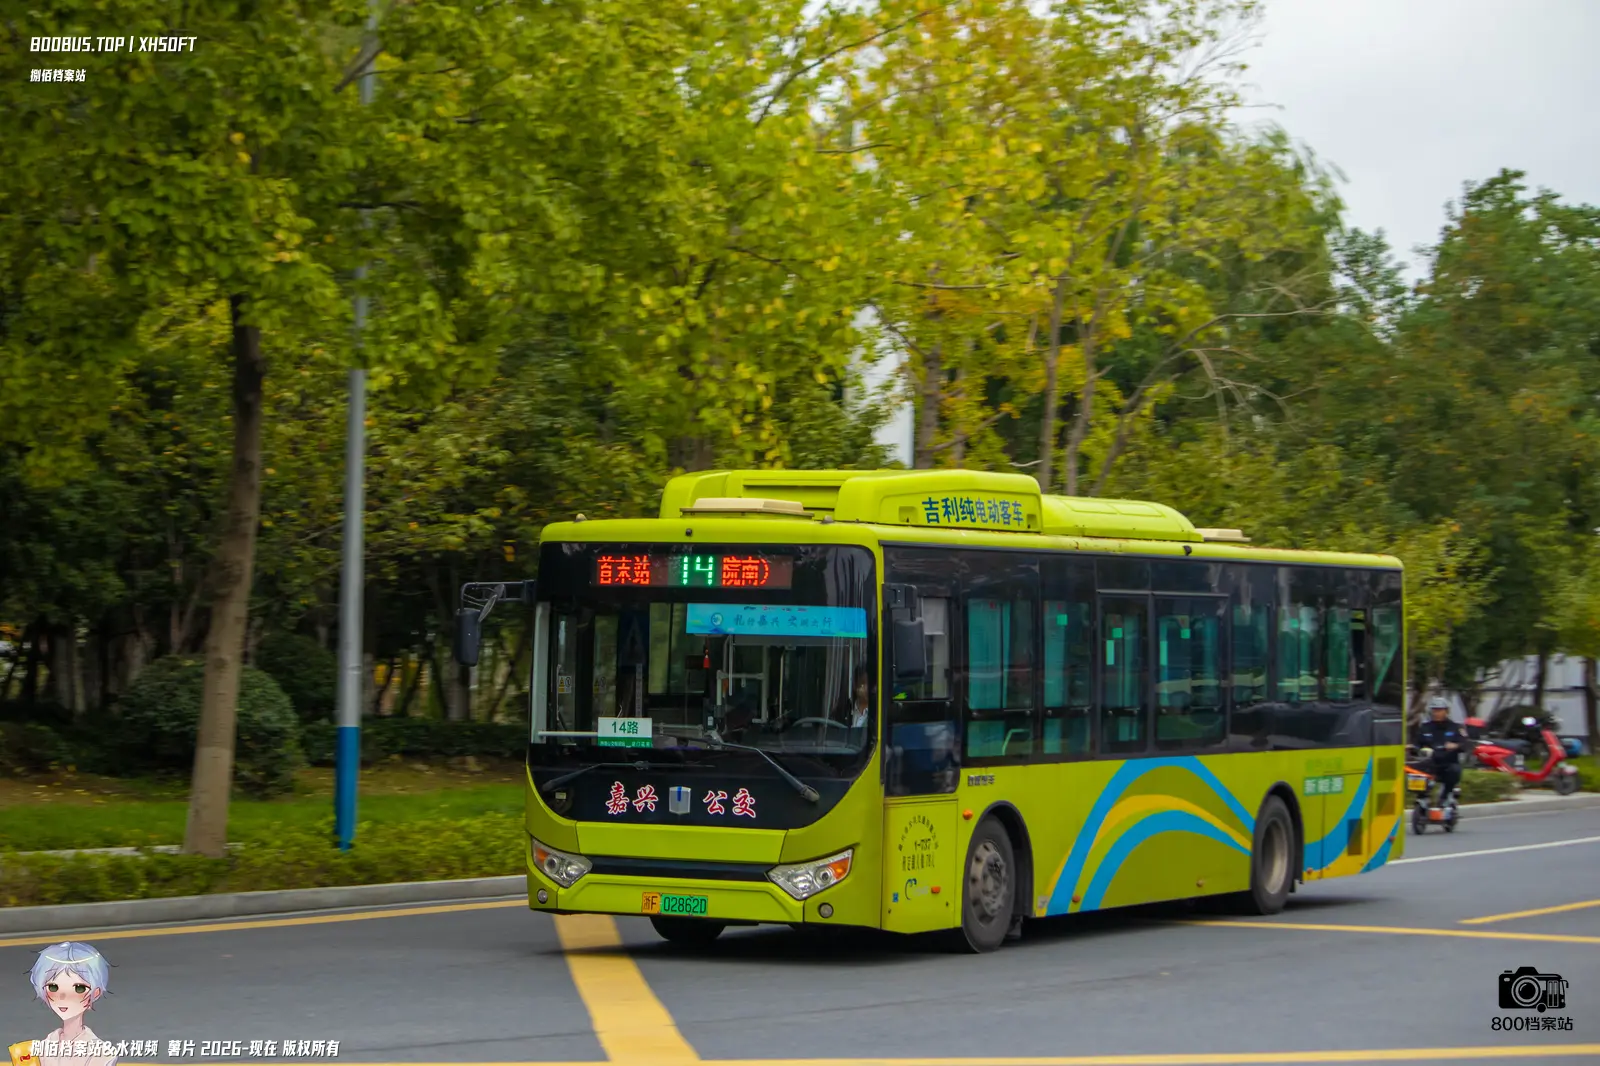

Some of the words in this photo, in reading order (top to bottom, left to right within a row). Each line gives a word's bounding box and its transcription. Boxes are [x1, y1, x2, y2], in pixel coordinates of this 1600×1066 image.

[922, 497, 1023, 526] 吉利纯电动客车
[598, 555, 650, 585] 首末站
[682, 556, 713, 585] 14
[611, 721, 639, 735] 14路
[605, 781, 659, 815] 嘉兴
[703, 788, 757, 818] 公交
